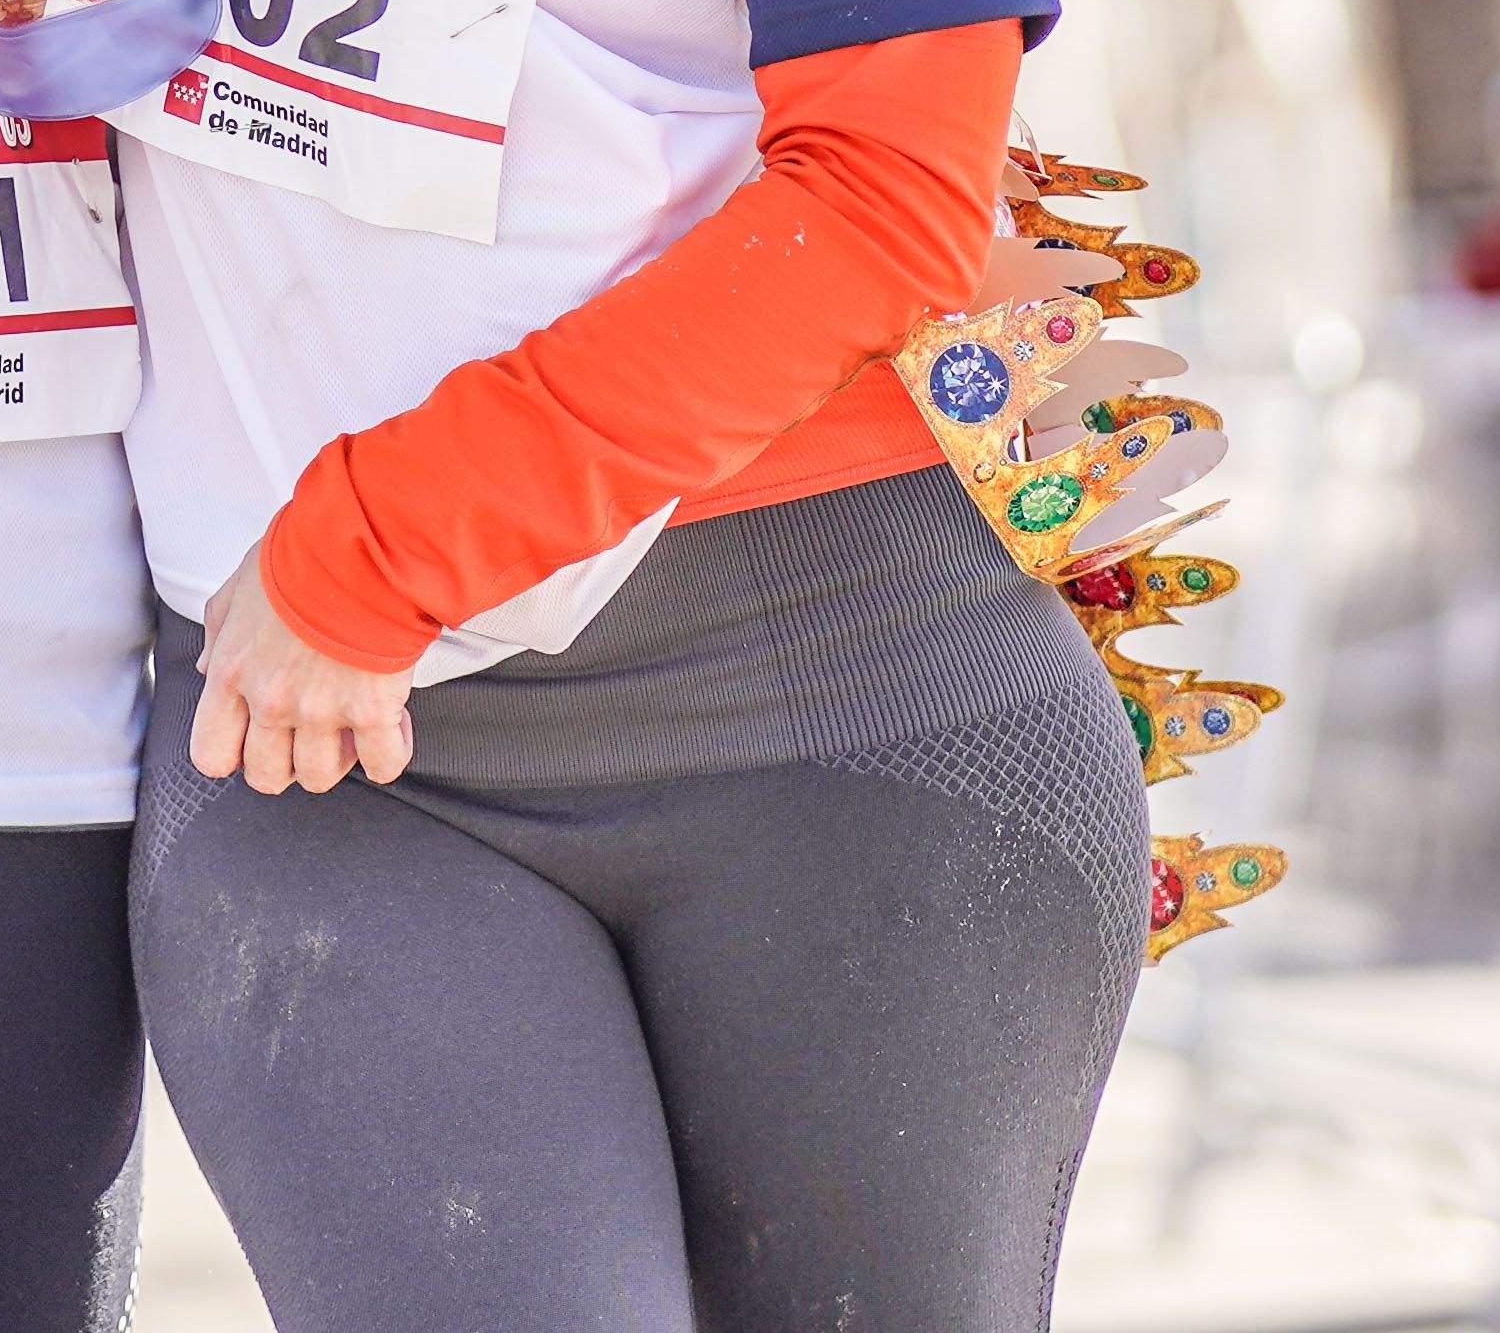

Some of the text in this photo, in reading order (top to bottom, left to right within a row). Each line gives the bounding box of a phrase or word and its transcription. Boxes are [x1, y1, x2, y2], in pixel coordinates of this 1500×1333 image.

[212, 80, 329, 138] Comunidad
[208, 110, 328, 167] de Madrid
